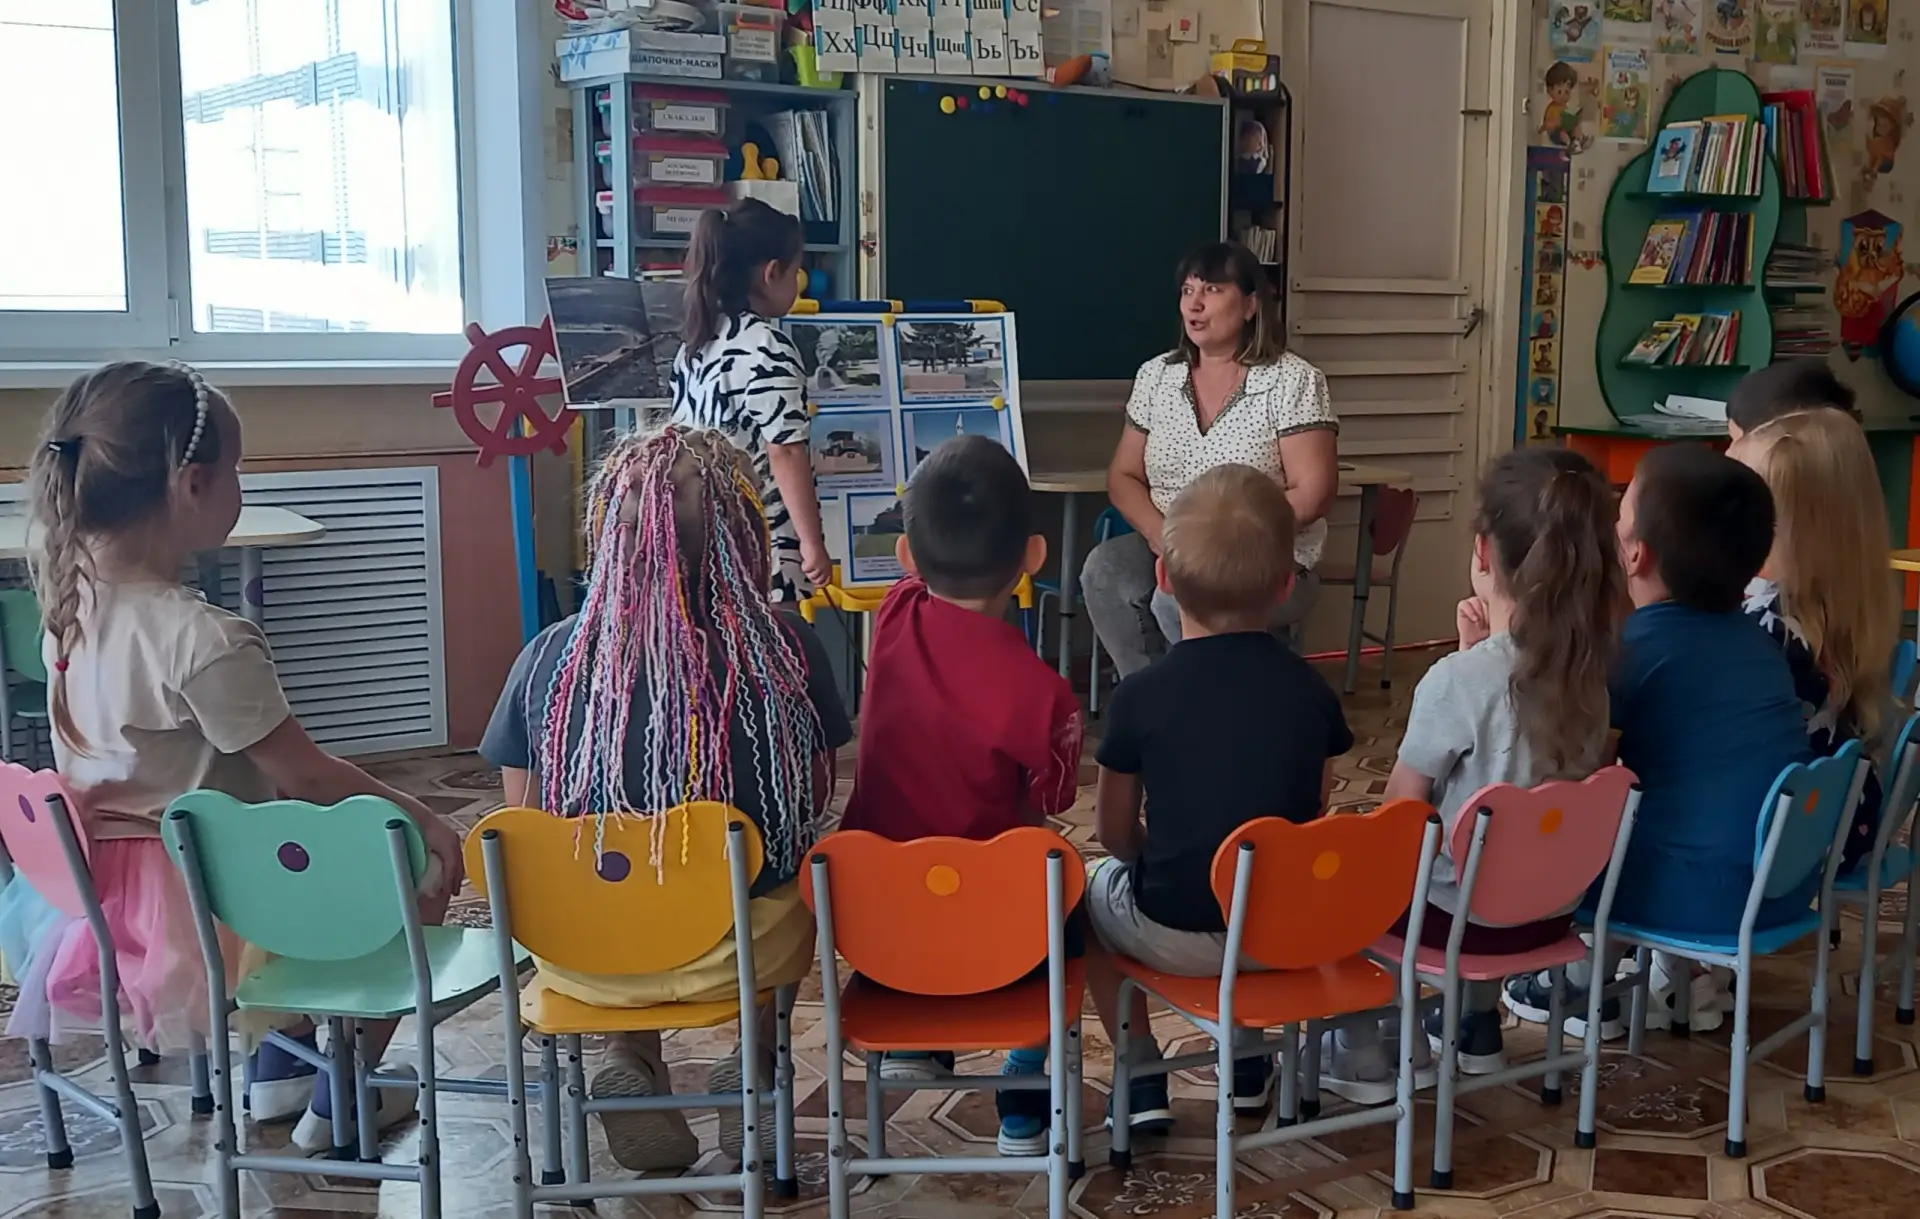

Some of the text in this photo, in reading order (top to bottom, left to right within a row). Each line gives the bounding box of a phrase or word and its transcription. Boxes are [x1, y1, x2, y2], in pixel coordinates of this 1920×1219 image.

[824, 31, 857, 53] Хх
[863, 24, 894, 51] Цц
[901, 36, 928, 57] Чч
[936, 37, 966, 54] Щщ
[976, 39, 1002, 59] Ьь
[1010, 39, 1039, 59] Ъъ
[631, 54, 719, 69] ШАПОЧКИ-МАСКИ
